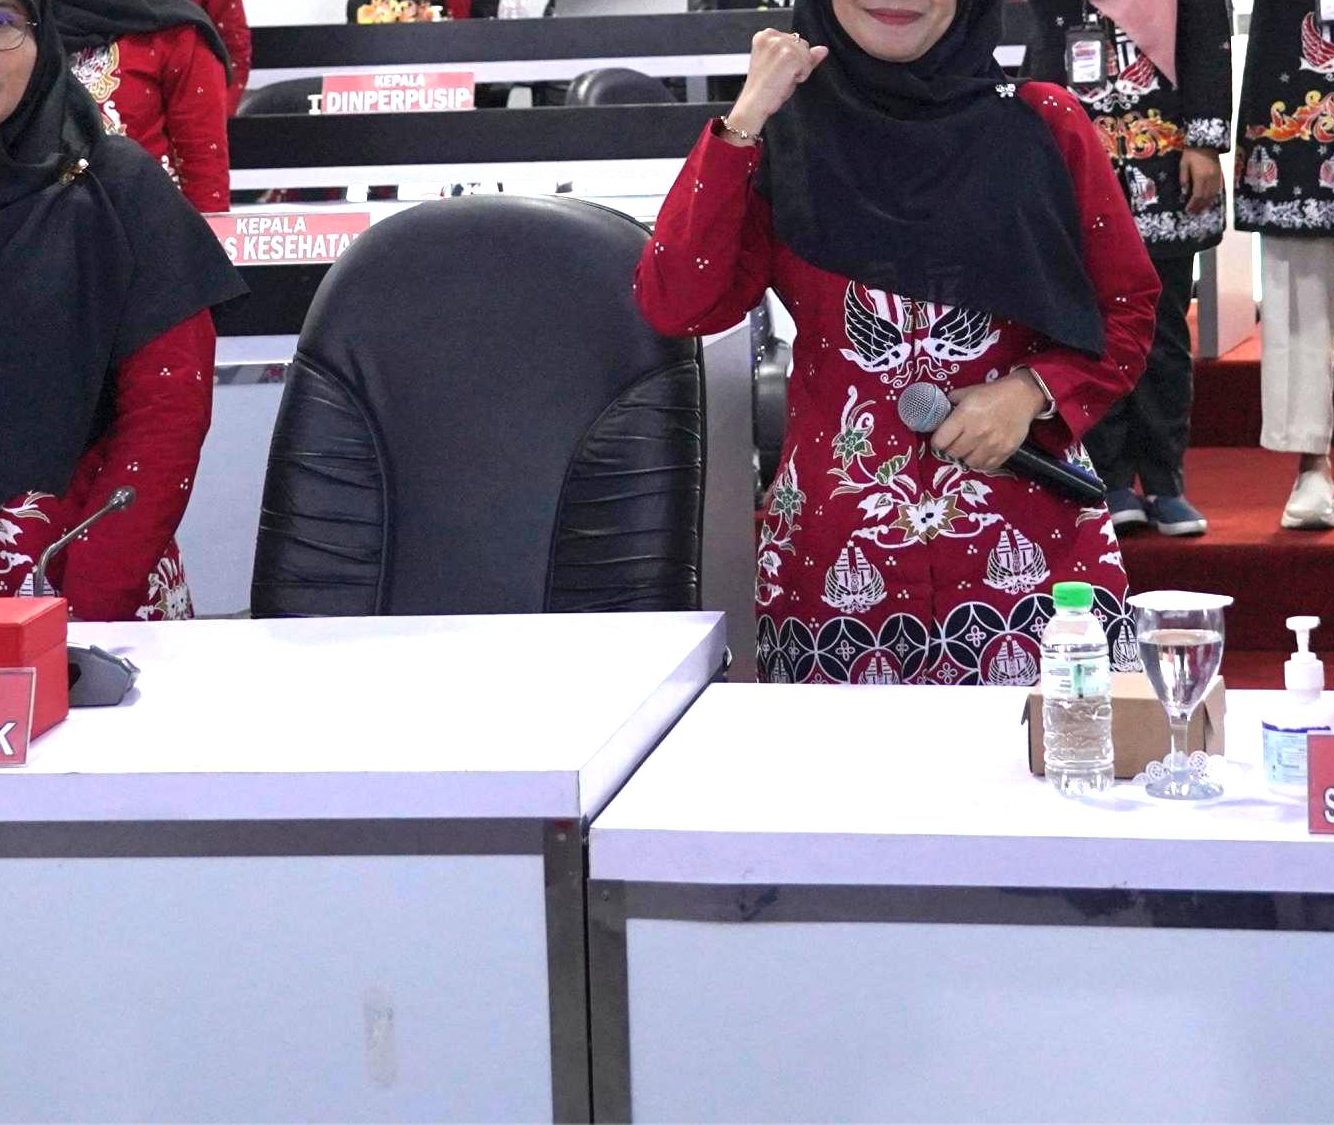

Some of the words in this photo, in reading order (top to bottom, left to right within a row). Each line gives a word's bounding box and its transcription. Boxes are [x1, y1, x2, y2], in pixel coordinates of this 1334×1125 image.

[374, 74, 425, 88] KEPALA
[327, 87, 473, 113] DINPERPUSIP
[236, 217, 307, 234] KEPALA
[244, 233, 359, 260] KESEHATA
